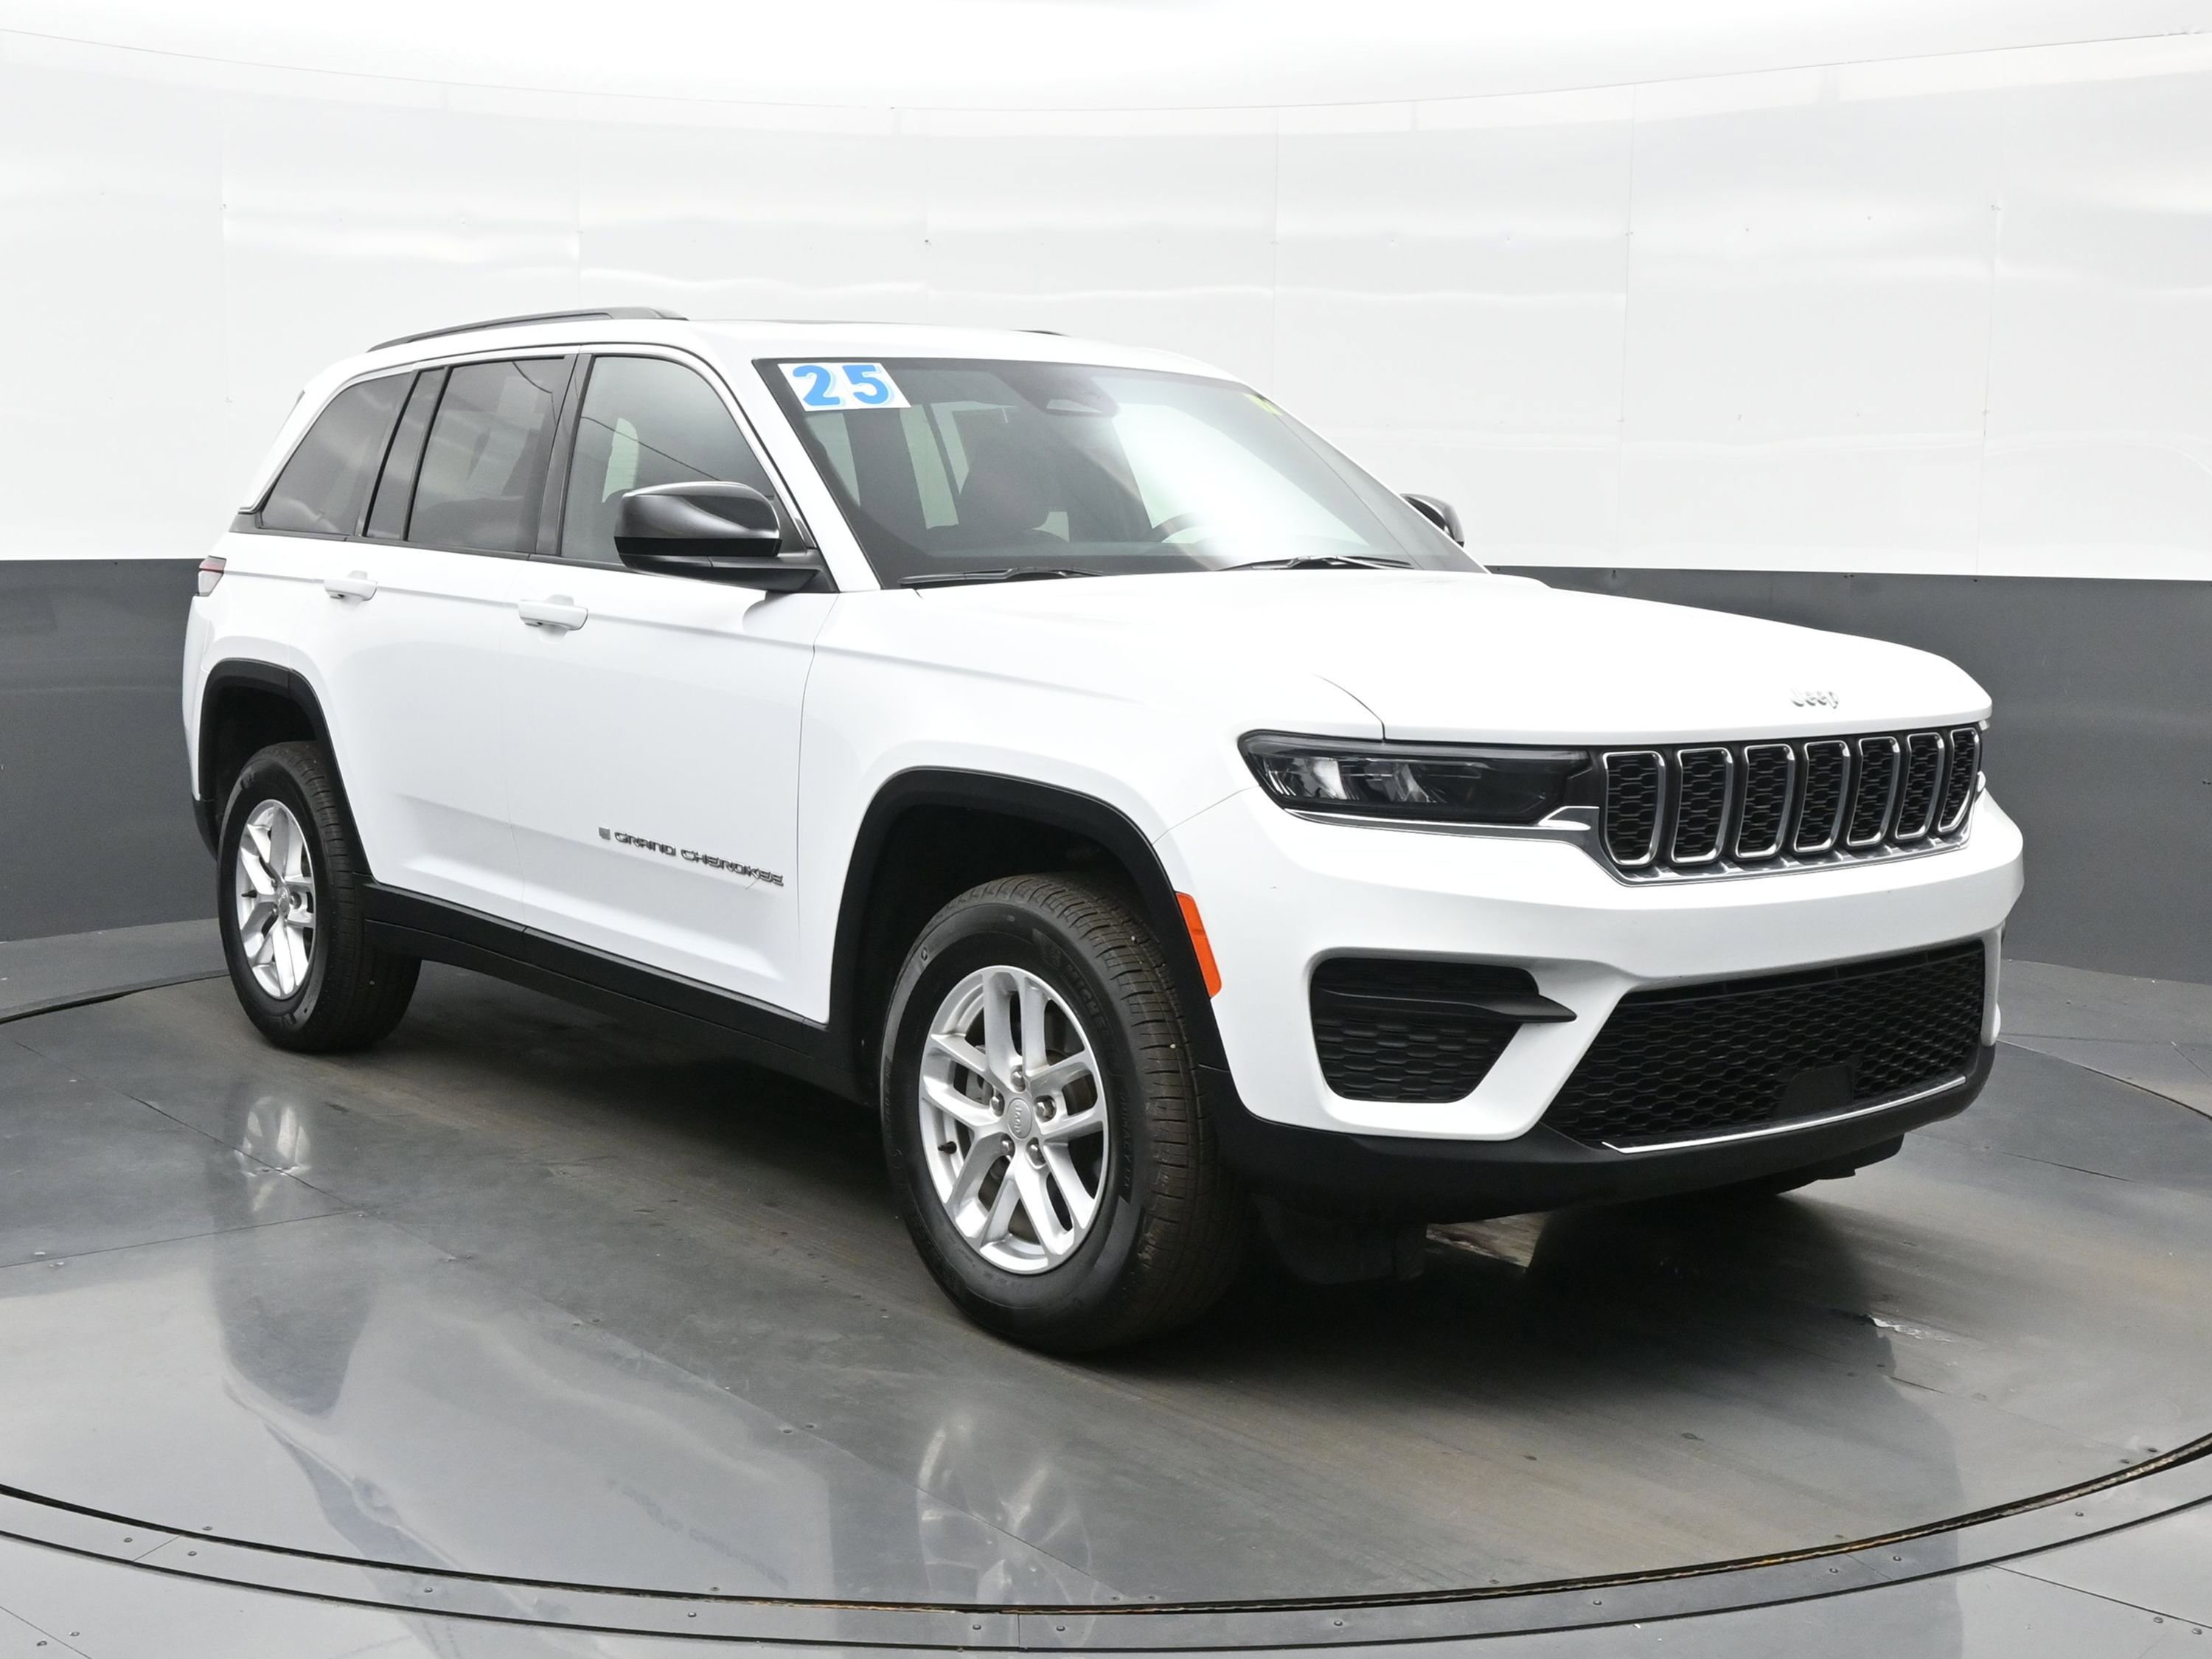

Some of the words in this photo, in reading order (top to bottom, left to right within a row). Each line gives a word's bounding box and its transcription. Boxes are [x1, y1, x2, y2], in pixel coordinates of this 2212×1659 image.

[792, 364, 891, 406] 25
[1790, 688, 1839, 710] Jeep
[614, 832, 677, 856] GRAND
[681, 849, 785, 887] CHEROKEE
